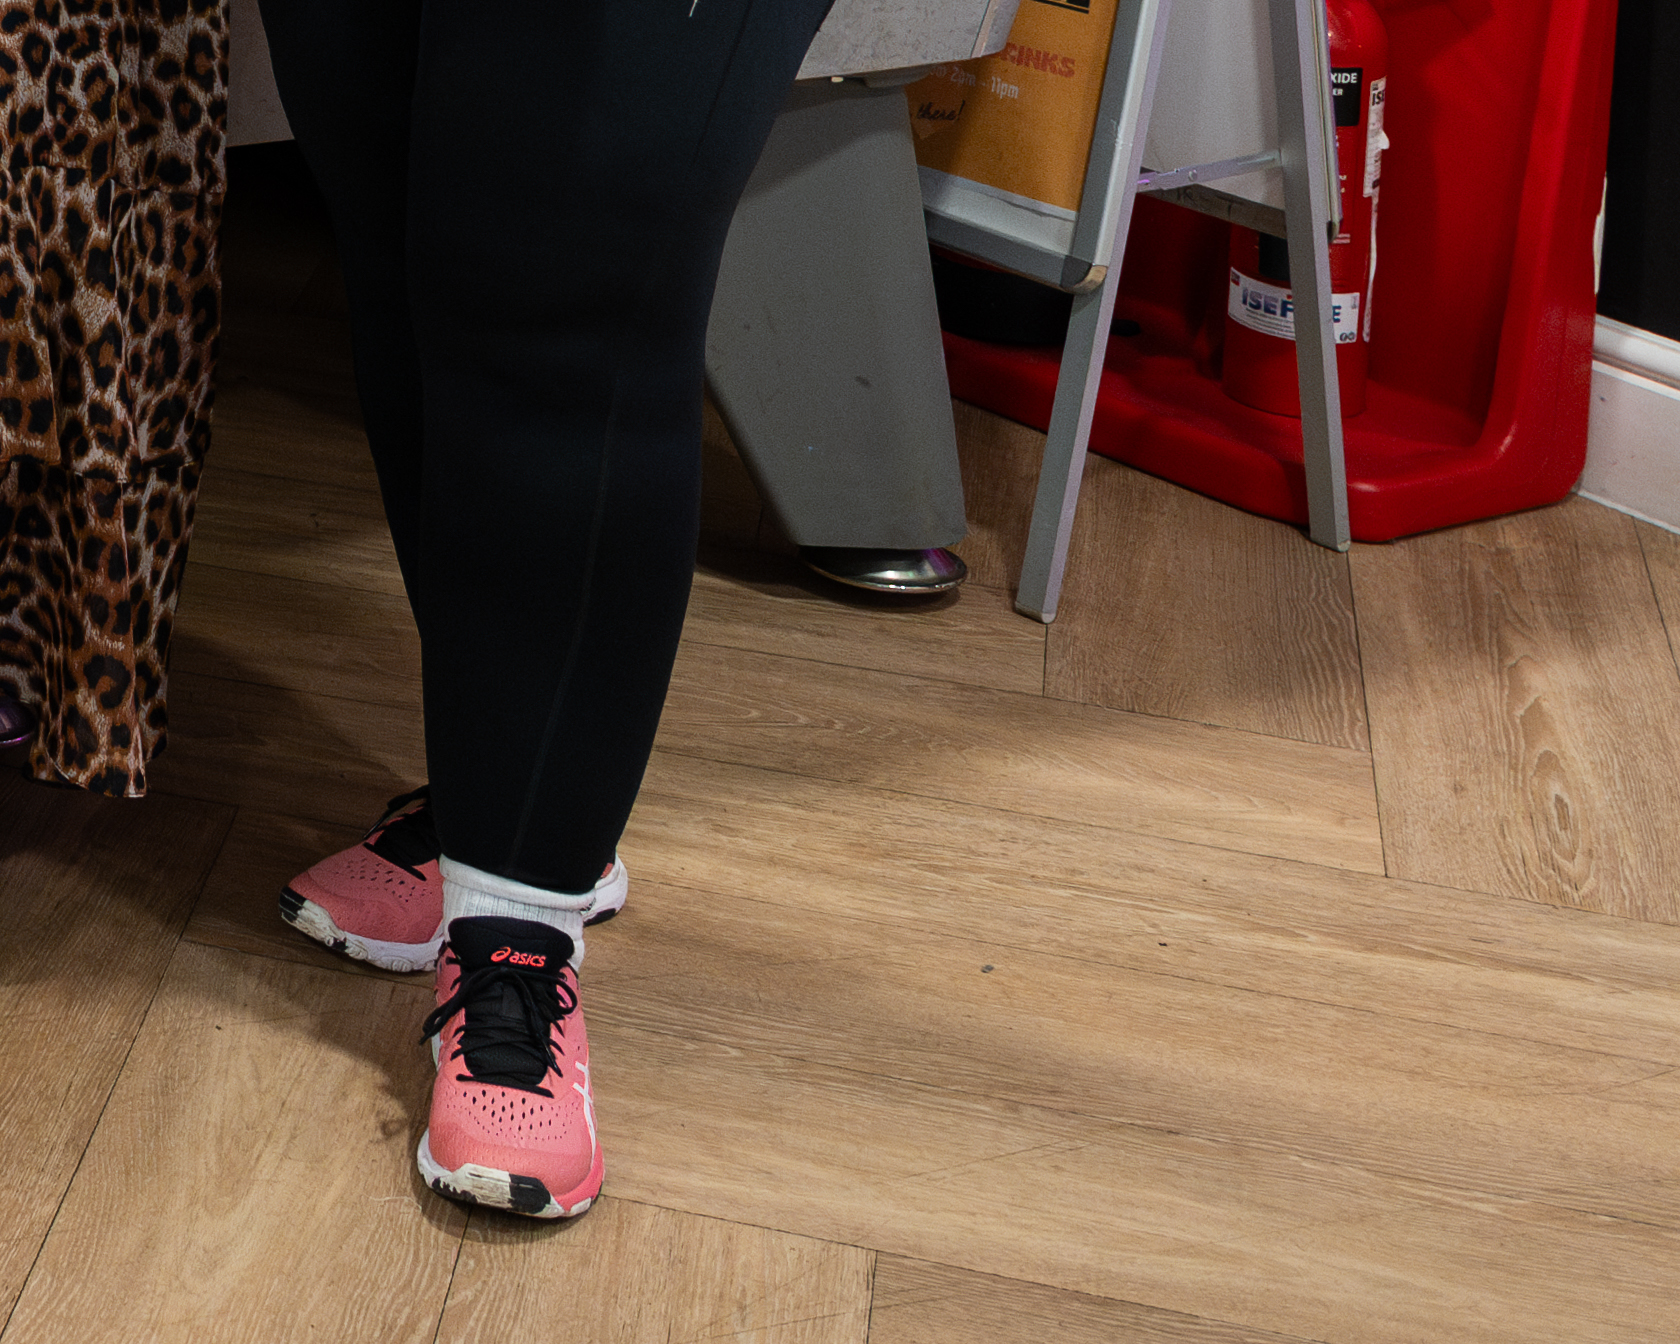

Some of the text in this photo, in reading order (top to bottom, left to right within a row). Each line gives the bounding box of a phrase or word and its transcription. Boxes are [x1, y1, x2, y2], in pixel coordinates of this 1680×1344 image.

[1000, 41, 1077, 79] RINKS
[991, 75, 1020, 100] 11pm
[1331, 72, 1358, 84] XIDE
[509, 951, 546, 968] asics
